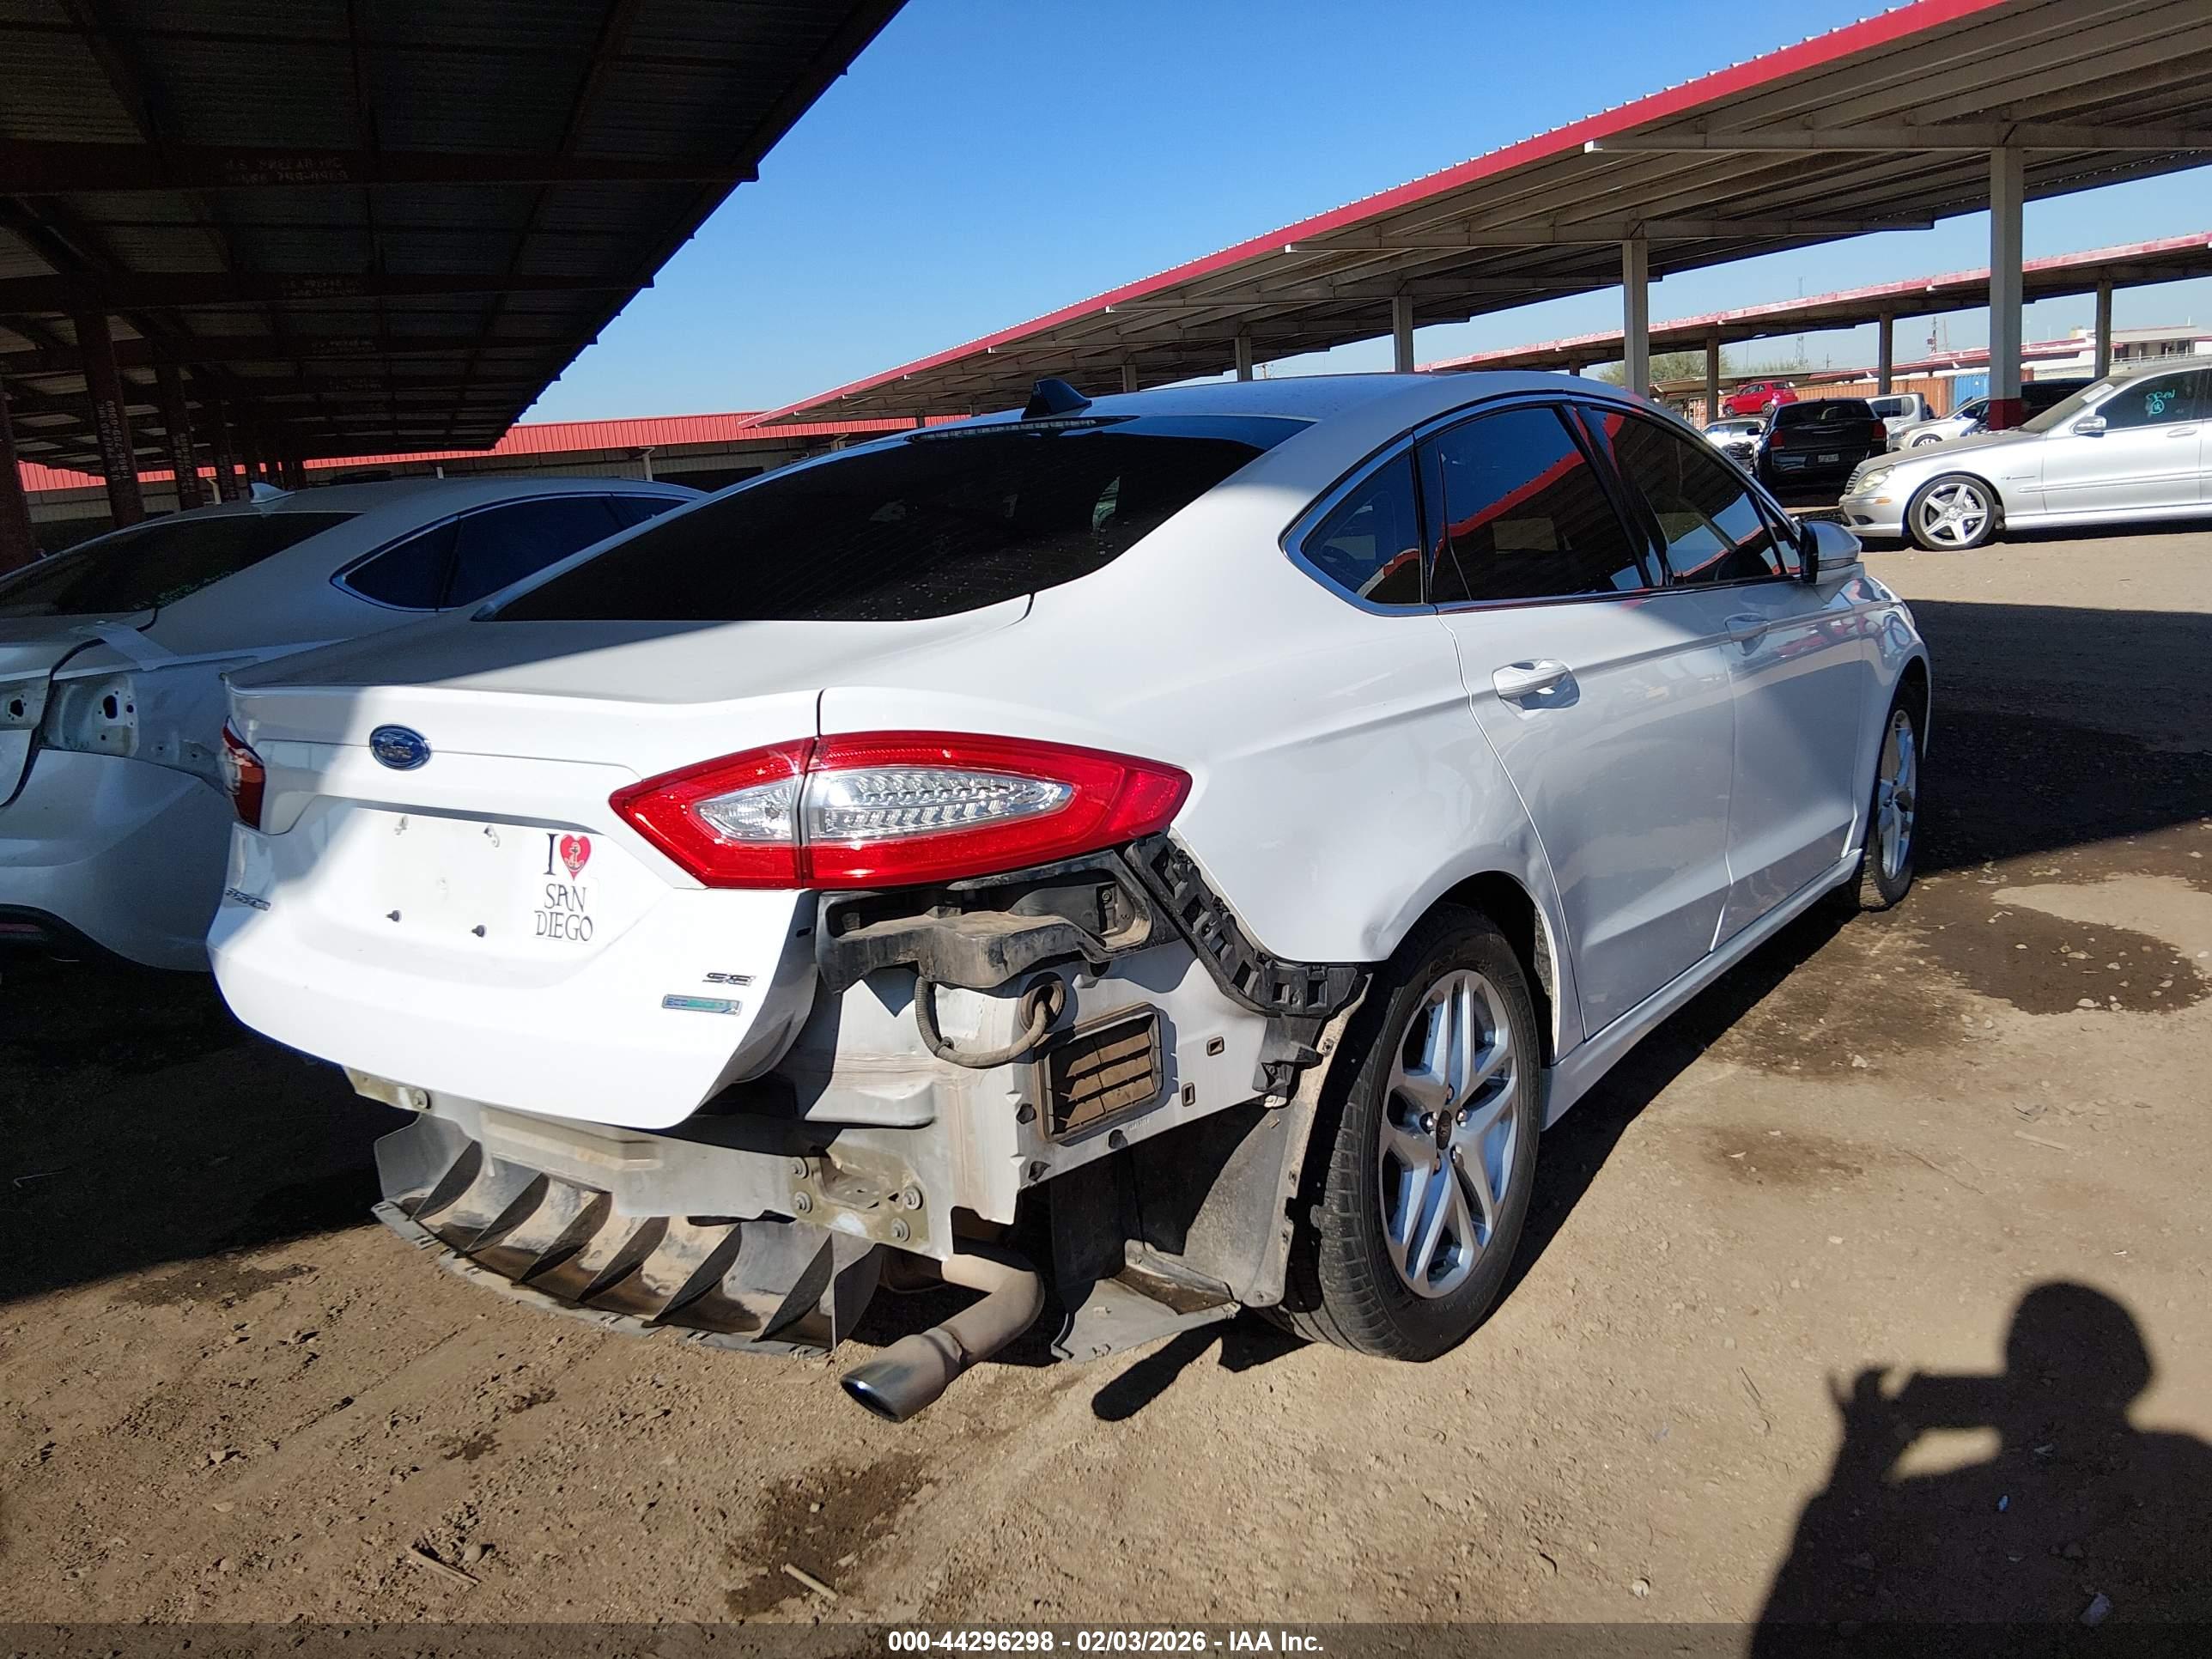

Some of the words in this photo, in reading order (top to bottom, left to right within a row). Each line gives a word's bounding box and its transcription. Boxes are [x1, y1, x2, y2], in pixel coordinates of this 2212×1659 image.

[543, 832, 560, 876] I
[544, 883, 586, 912] SAN
[534, 910, 592, 941] DIEGO
[702, 972, 756, 987] SE
